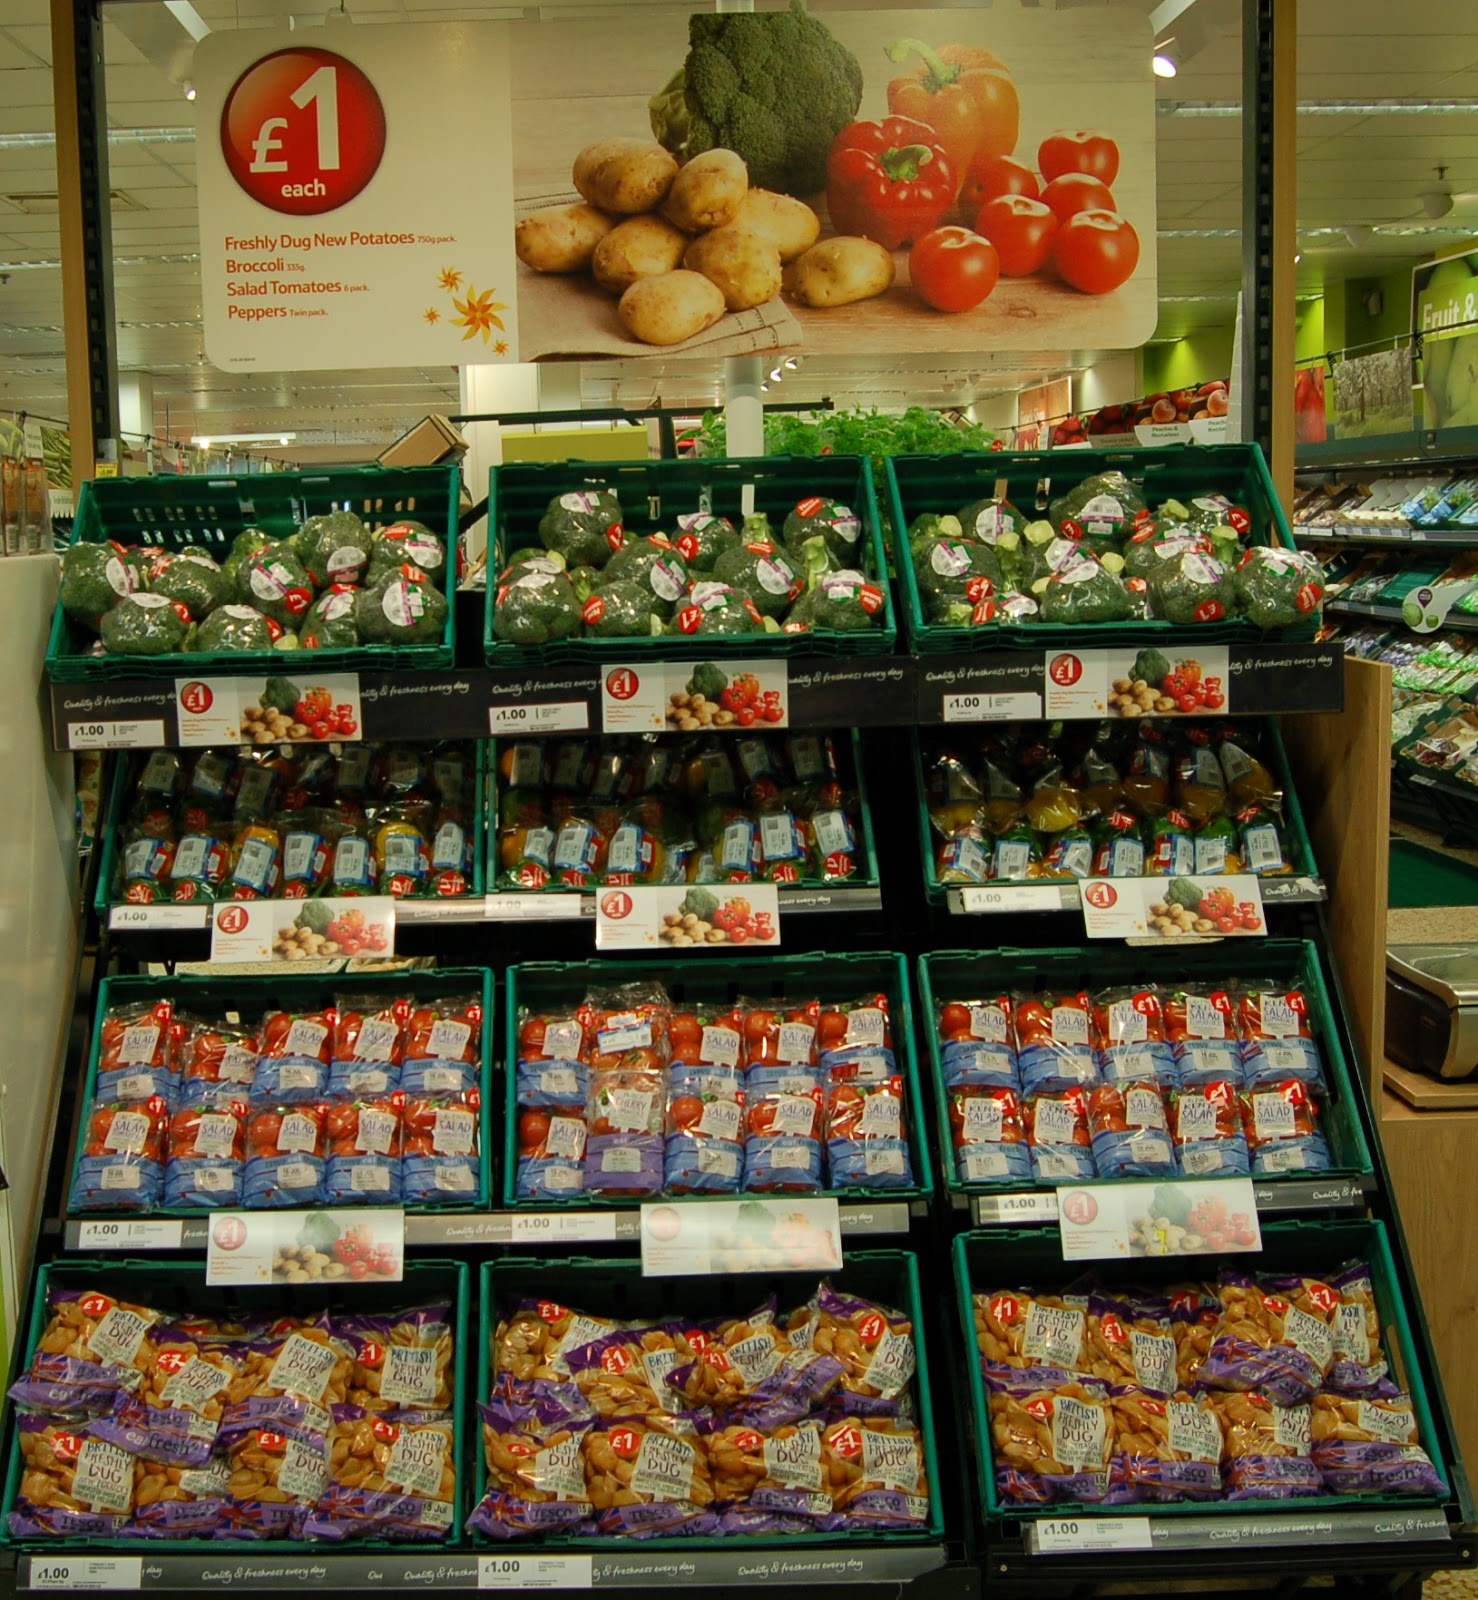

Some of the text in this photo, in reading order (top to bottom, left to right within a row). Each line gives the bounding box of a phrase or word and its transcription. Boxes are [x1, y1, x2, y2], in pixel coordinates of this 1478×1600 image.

[250, 66, 340, 172] £1
[281, 179, 326, 197] each
[225, 232, 457, 252] Freshly Dug New Potatoes 750g pack.
[226, 258, 284, 273] Broccoli
[227, 282, 268, 296] Salad
[270, 281, 342, 294] Tomatoes
[350, 284, 370, 293] pack.
[228, 305, 328, 321] Peppers Twin pack.
[1422, 292, 1477, 334] Fruit &
[1056, 658, 1073, 679] £1
[1230, 655, 1332, 674] lity & freshness every day
[612, 672, 631, 693] £1
[813, 672, 821, 683] &
[823, 672, 862, 683] freshness
[863, 671, 886, 681] every
[888, 668, 904, 680] day
[926, 672, 956, 683] Quality
[957, 668, 965, 679] &
[967, 668, 1005, 679] freshness
[1007, 666, 1029, 677] every
[187, 686, 204, 706] £1
[360, 681, 469, 702] ality & freshness every day
[492, 681, 597, 697] Quality & freshness every
[64, 698, 93, 711] Quality
[95, 695, 103, 706] &
[104, 696, 141, 707] freshness
[143, 695, 165, 705] every
[950, 698, 979, 708] £1.00
[496, 709, 526, 721] £1.00
[75, 726, 104, 736] £1.00
[816, 895, 831, 905] day
[972, 893, 1001, 904] £1.00
[1092, 887, 1110, 904] £1
[606, 895, 624, 914] £1
[117, 912, 147, 921] £1.00
[222, 911, 241, 928] £1
[1138, 996, 1156, 1012] £1
[1215, 996, 1230, 1009] £1
[1291, 996, 1304, 1009] £1
[852, 1018, 882, 1030] SALAD
[976, 1012, 1004, 1026] SALAD
[1056, 1017, 1086, 1027] SALAD
[707, 1035, 737, 1048] SALAD
[781, 1104, 812, 1116] SALAD
[968, 1113, 1000, 1123] SALAD
[1257, 1108, 1290, 1117] SALAD
[201, 1124, 232, 1135] SALAD
[1259, 1188, 1273, 1199] day
[1312, 1189, 1340, 1200] Quality
[1004, 1198, 1036, 1209] £1.00
[1070, 1195, 1088, 1218] £1
[518, 1218, 550, 1229] £1.00
[859, 1212, 873, 1223] day
[86, 1224, 118, 1235] £1.00
[446, 1226, 474, 1238] Quality
[82, 1299, 105, 1311] £1
[1313, 1289, 1330, 1305] £1
[1035, 1305, 1080, 1321] BRITISH
[861, 1320, 883, 1337] £1
[1032, 1314, 1077, 1330] FRESHLY
[1037, 1325, 1068, 1340] DUG
[293, 1339, 334, 1362] BRITISH
[287, 1347, 328, 1374] FRESHLY
[288, 1360, 317, 1380] DUG
[1060, 1399, 1099, 1419] BRITISH
[1058, 1413, 1098, 1431] FRESHLY
[612, 1434, 633, 1448] £1
[1061, 1426, 1093, 1442] DUG
[148, 1433, 190, 1456] fresh
[645, 1435, 691, 1456] BRITISH
[84, 1452, 131, 1470] FRESHLY
[401, 1448, 434, 1466] DUG
[88, 1463, 122, 1483] DUG
[647, 1458, 681, 1477] DUG
[1370, 1467, 1416, 1483] fresh
[63, 1516, 105, 1528] TESCO
[533, 1509, 572, 1519] TESCO
[1044, 1522, 1078, 1535] £1.00
[1152, 1528, 1169, 1540] day
[1210, 1522, 1332, 1542] Quality & freshness every day
[1375, 1523, 1405, 1536] Quality
[1406, 1519, 1414, 1530] &
[38, 1568, 69, 1579] £1.00
[146, 1565, 162, 1578] day
[202, 1565, 326, 1584] Quality & freshness every day
[485, 1560, 520, 1573] £1.00
[613, 1566, 652, 1577] freshness
[654, 1565, 677, 1576] every
[679, 1561, 695, 1575] day
[738, 1558, 863, 1579] Quality & freshness every day
[404, 1570, 434, 1583] Quality
[436, 1567, 445, 1578] &
